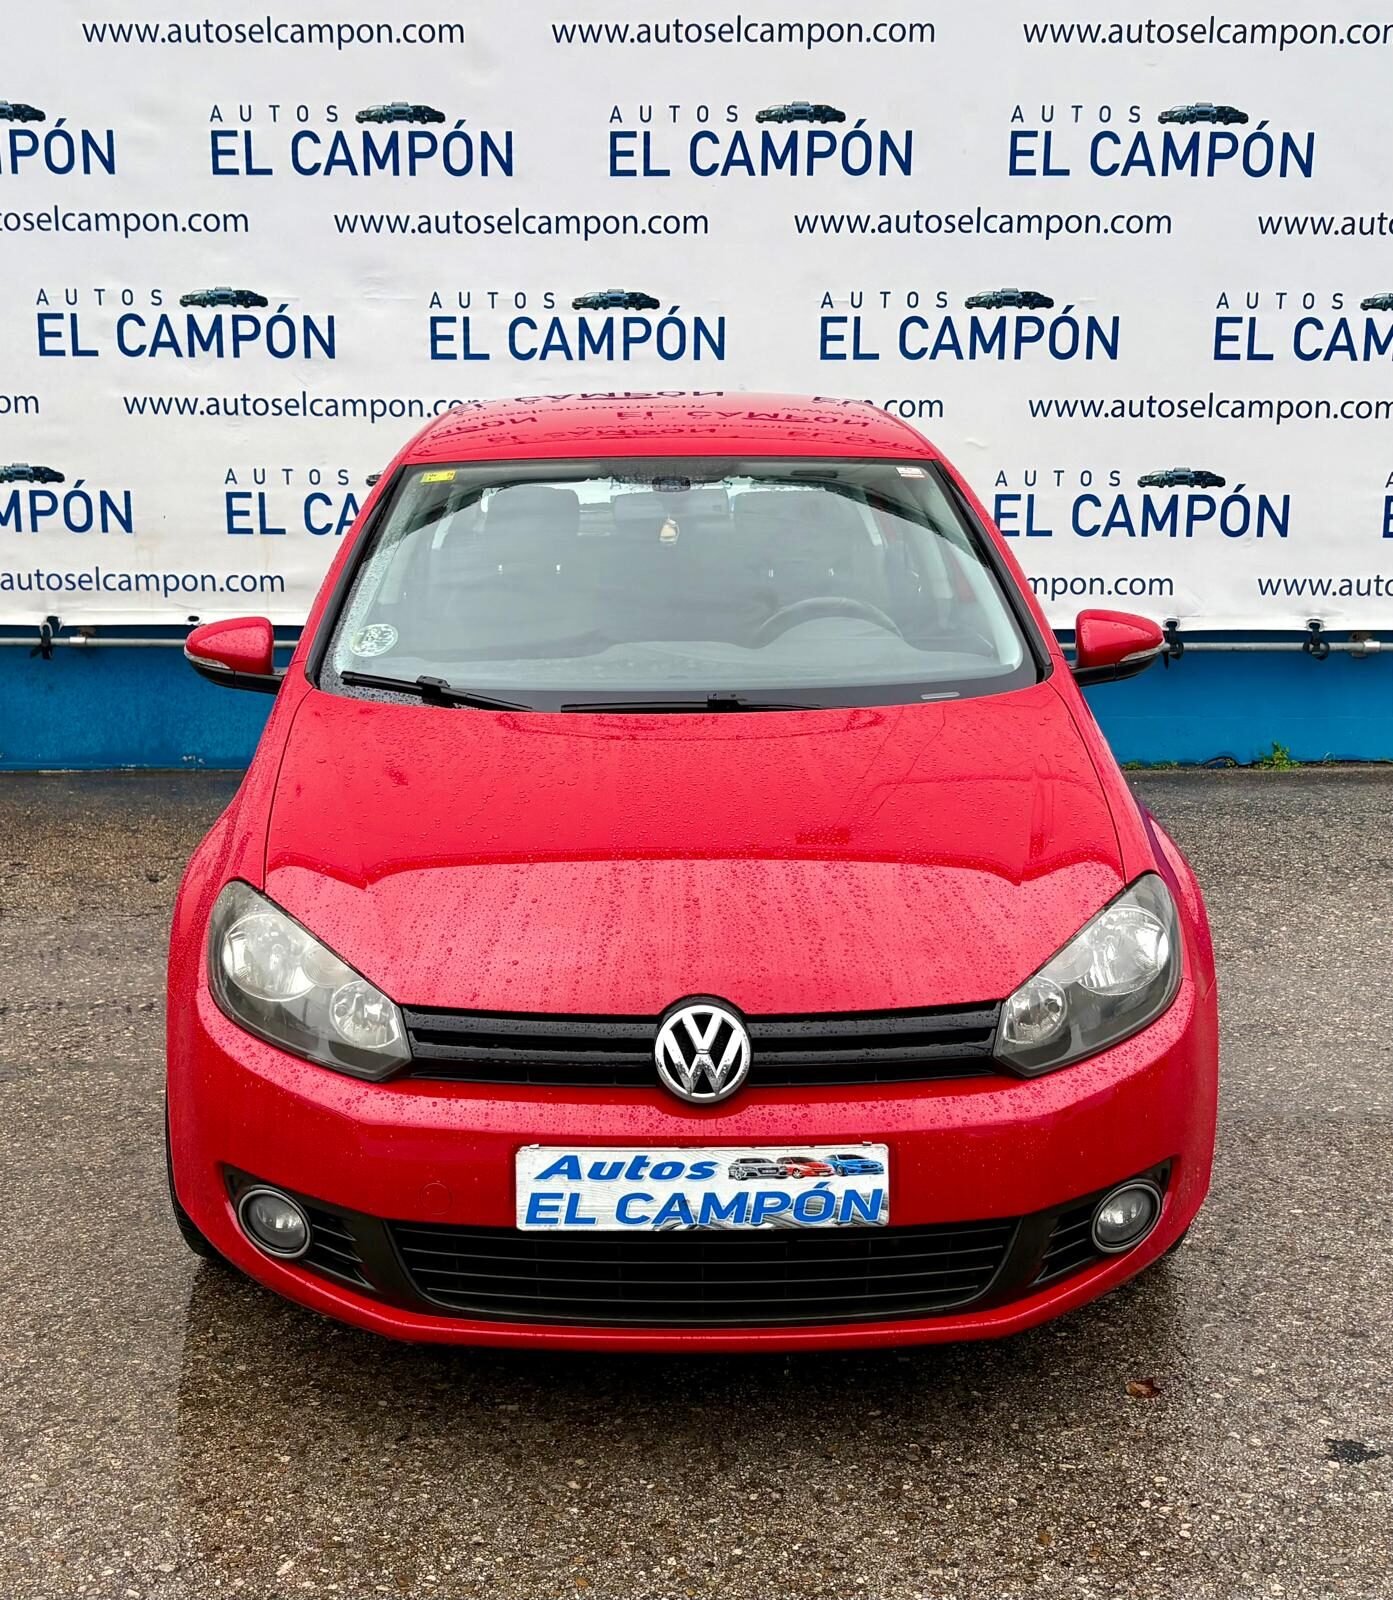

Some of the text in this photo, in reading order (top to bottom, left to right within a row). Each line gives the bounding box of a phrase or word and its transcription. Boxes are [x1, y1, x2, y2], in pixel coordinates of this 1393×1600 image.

[82, 16, 464, 50] www.autoselcampon.com
[552, 15, 934, 49] www.autoselcampon.com
[210, 105, 338, 122] AUTOS
[610, 105, 737, 123] AUTOS
[1011, 105, 1140, 123] AUTOS
[0, 118, 115, 174] PÓN
[211, 118, 512, 176] EL CAMPÓN
[610, 118, 912, 176] EL CAMPÓN
[1009, 120, 1314, 177] EL CAMPÓN
[334, 208, 708, 241] www.autoselcampon.com
[795, 207, 1171, 240] www.autoselcampon.com
[1259, 213, 1393, 235] www.aut
[37, 289, 162, 306] AUTOS
[430, 292, 554, 309] AUTOS
[821, 292, 947, 308] AUTOS
[1217, 292, 1343, 309] AUTOS
[37, 303, 335, 359] EL CAMPÓN
[430, 306, 725, 361] EL CAMPÓN
[820, 304, 1119, 360] EL CAMPÓN
[1214, 317, 1273, 360] EL
[225, 469, 348, 485] AUTOS
[995, 470, 1120, 486] AUTOS
[226, 492, 286, 535] EL
[994, 484, 1290, 537] EL CAMPÓN
[659, 1008, 748, 1098] VW
[534, 1153, 719, 1182] Autos
[525, 1182, 884, 1226] EL CAMPÓN
